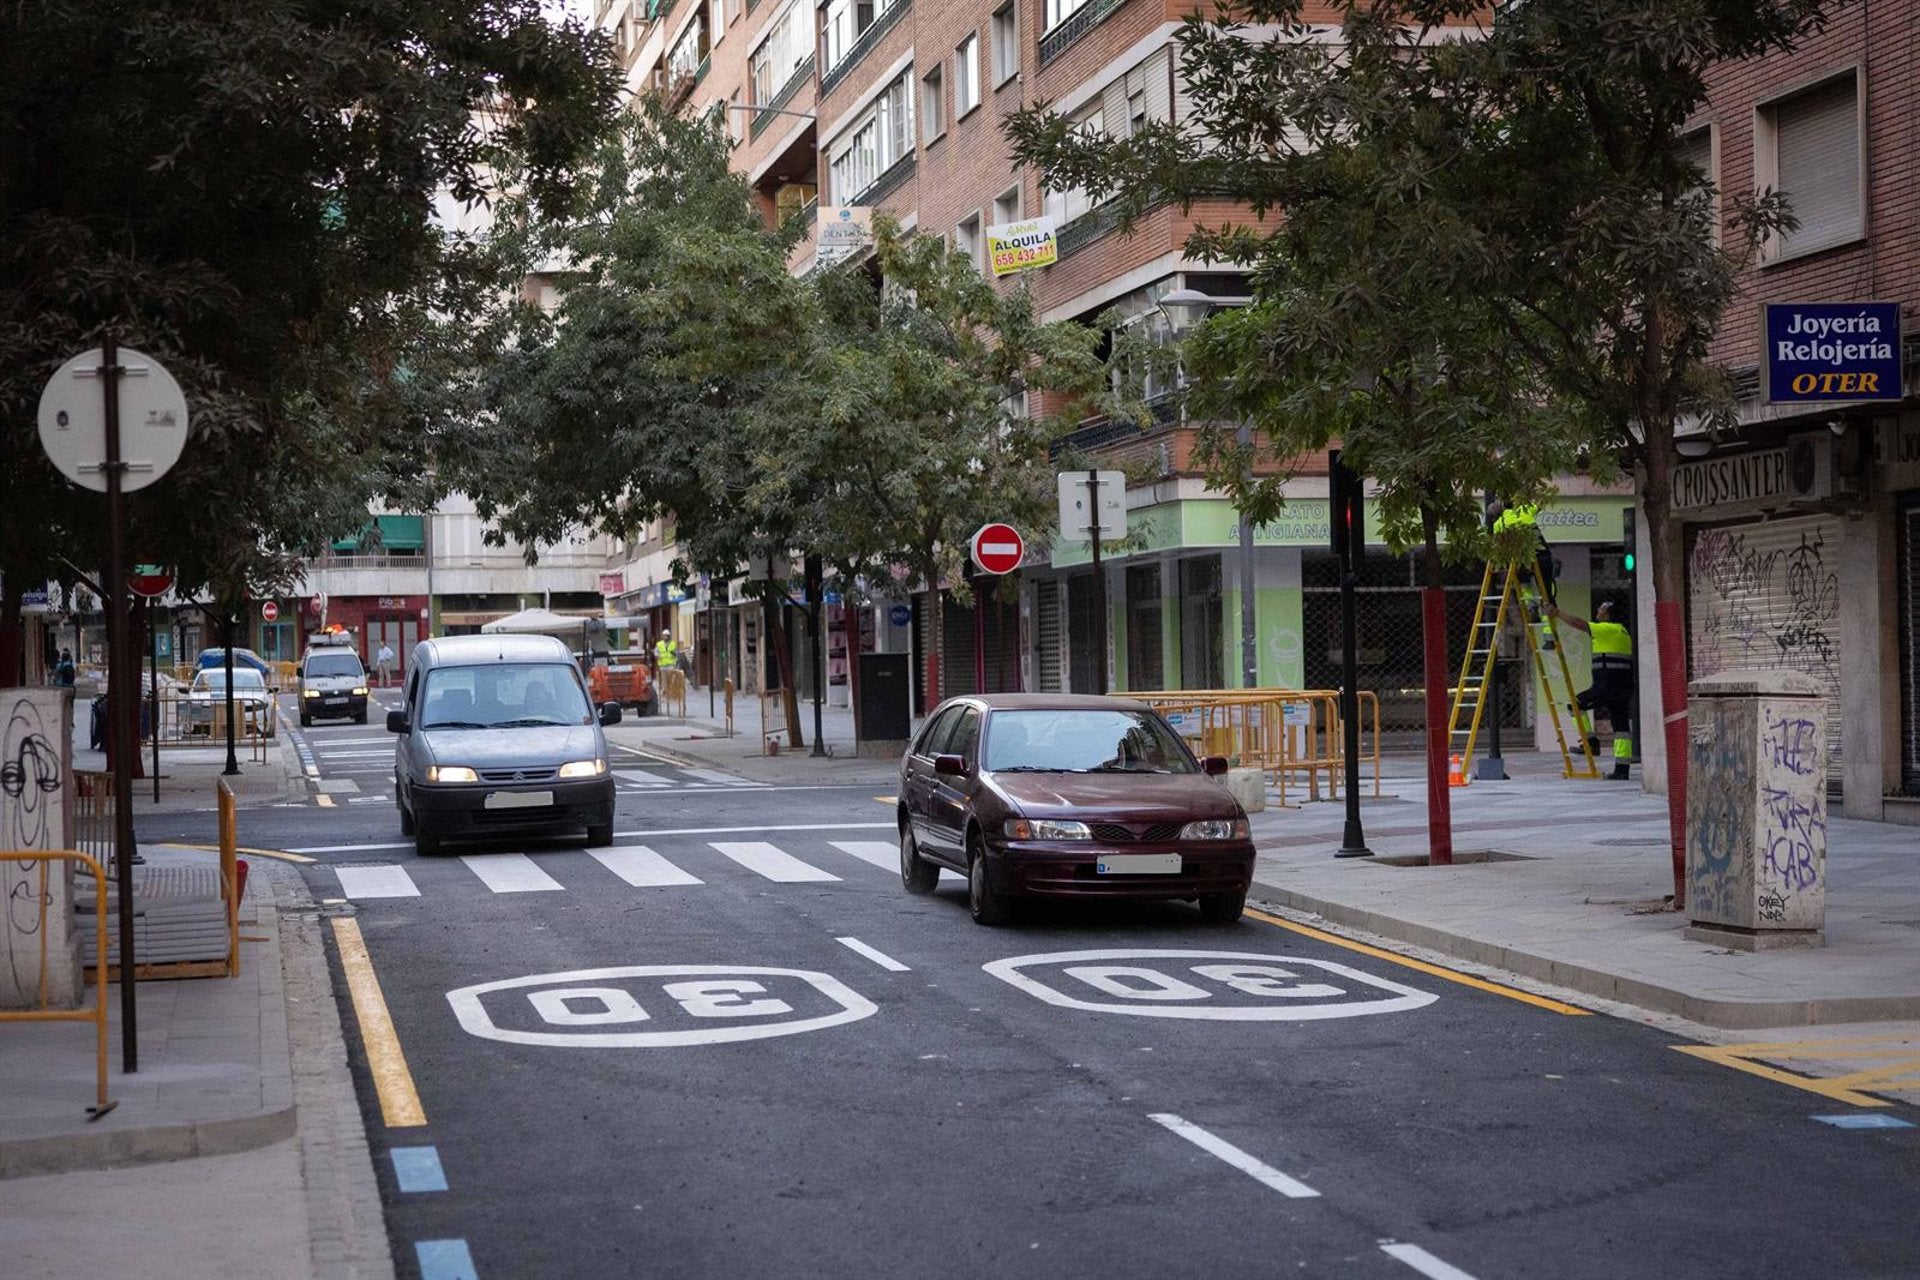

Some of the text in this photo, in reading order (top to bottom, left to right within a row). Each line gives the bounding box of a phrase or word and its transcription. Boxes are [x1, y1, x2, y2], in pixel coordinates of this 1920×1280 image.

[995, 232, 1051, 251] ALQUILA
[995, 252, 1015, 266] 658
[1017, 248, 1036, 261] 432
[1787, 311, 1881, 338] Joyería
[1777, 338, 1893, 365] Relojería
[1792, 372, 1879, 394] OTER
[1280, 503, 1325, 520] LATO
[1764, 828, 1816, 891] ACAB
[1062, 965, 1346, 999] 30
[527, 980, 794, 1025] 30
